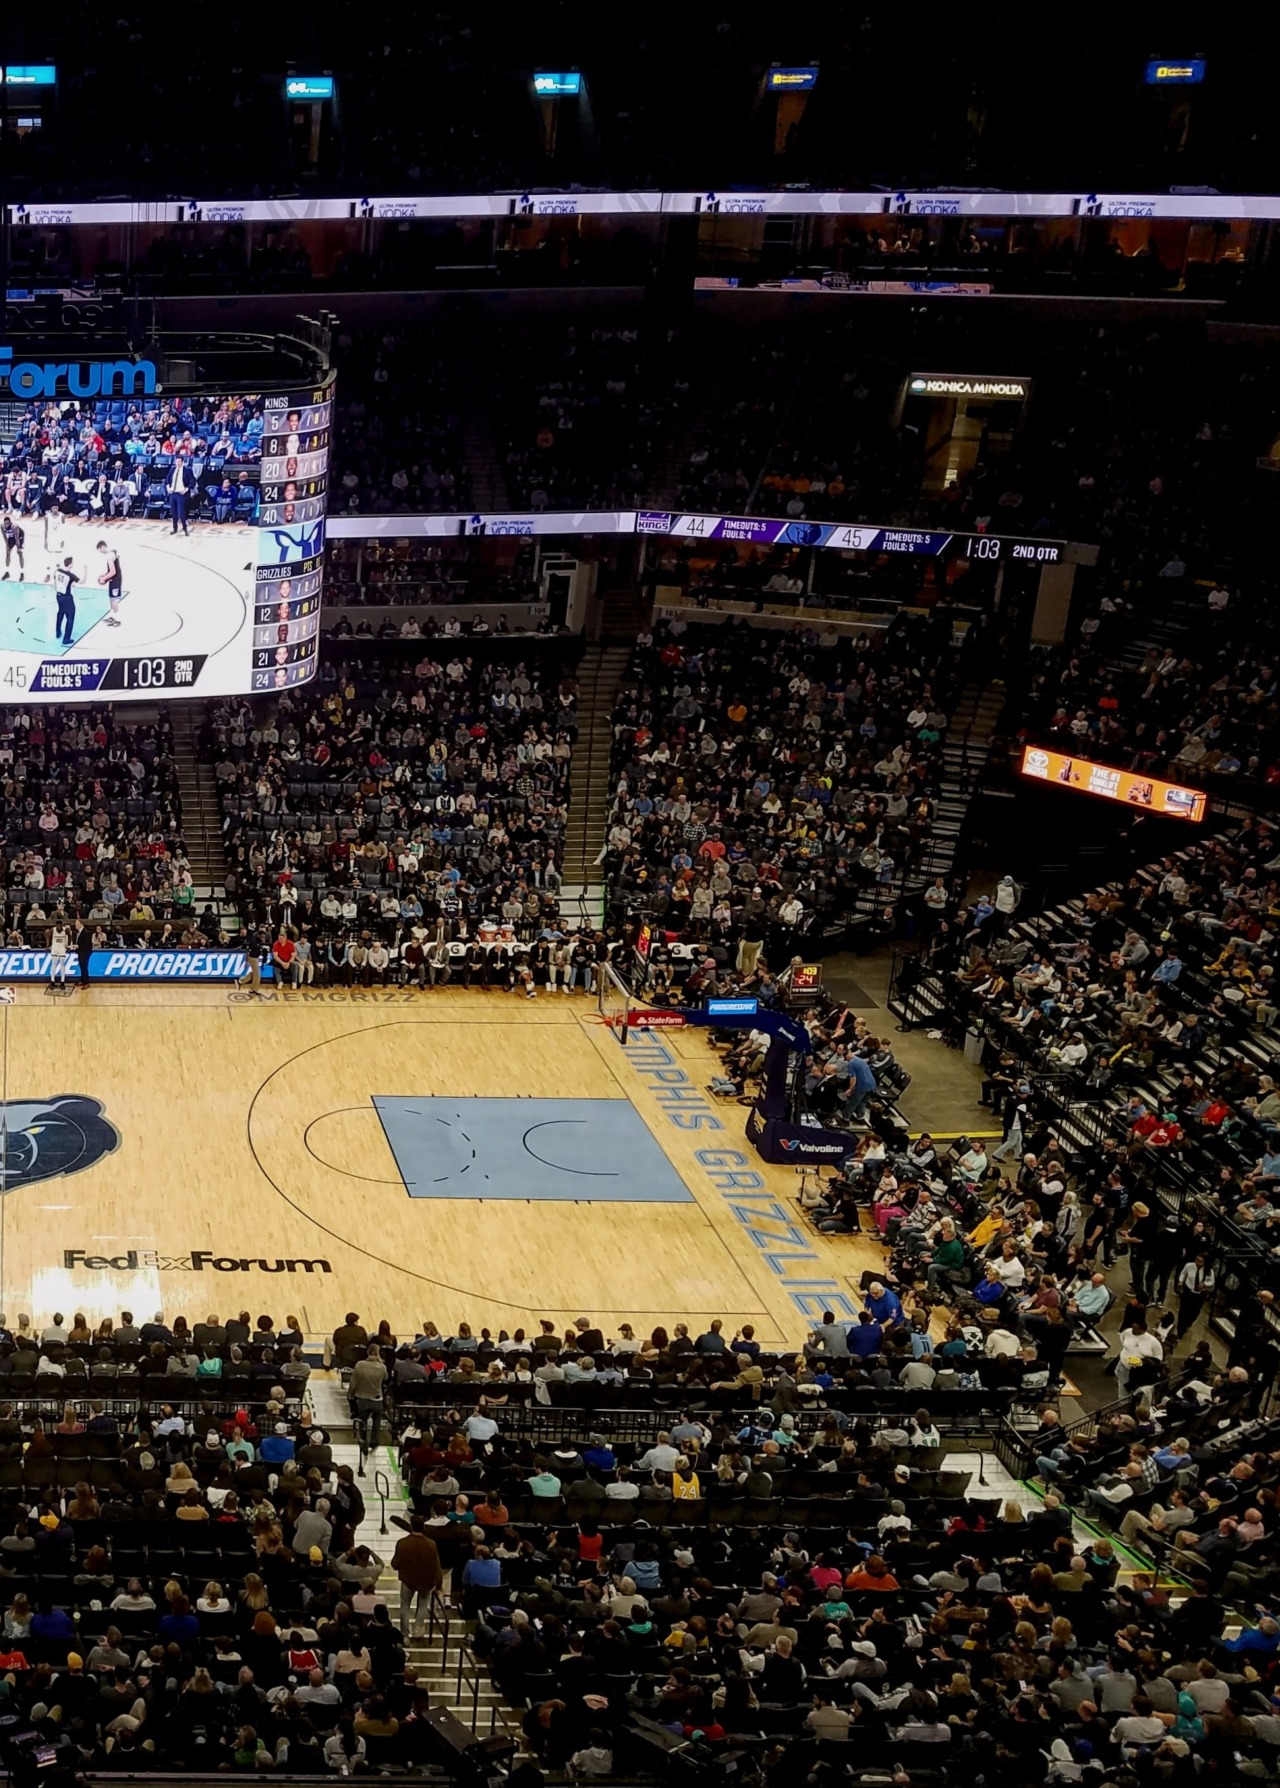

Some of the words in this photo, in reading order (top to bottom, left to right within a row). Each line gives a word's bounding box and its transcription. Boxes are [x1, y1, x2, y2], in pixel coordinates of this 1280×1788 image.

[916, 206, 958, 214] VODKA
[1108, 207, 1153, 216] VODKA
[927, 381, 972, 394] KONICA
[973, 382, 1024, 395] MINOLTA
[265, 397, 288, 409] KINGS
[271, 416, 279, 431] 5
[270, 439, 278, 453] 8
[266, 463, 279, 478] 20
[265, 487, 278, 501] 24
[263, 509, 277, 524] 40
[638, 521, 669, 530] KINGS
[687, 518, 704, 535] 44
[724, 520, 760, 531] TIMEOUTS:
[761, 523, 766, 531] 5
[722, 530, 747, 539] FOULS:
[747, 531, 752, 540] 4
[842, 529, 862, 547] 45
[885, 532, 924, 543] TIMEOUTS:
[925, 535, 931, 543] 5
[883, 541, 908, 551] FOULS:
[967, 538, 1000, 559] 1:03
[1013, 546, 1034, 558] 2ND
[1037, 548, 1058, 560] QTR
[257, 567, 292, 580] GRIZZLIES
[261, 608, 271, 621] 12
[260, 630, 270, 644] 14
[174, 660, 193, 671] 2ND
[258, 652, 269, 666] 21
[4, 666, 27, 687] 45
[41, 664, 91, 676] TIMEOUTS:
[92, 663, 99, 674] 5
[123, 659, 165, 687] 1:03
[41, 676, 74, 688] FOULS:
[74, 676, 81, 687] 5
[175, 671, 192, 683] QTR
[256, 673, 269, 687] 24
[609, 1029, 725, 1130] EMPHIS
[799, 1143, 843, 1152] Valvoline
[63, 1250, 332, 1273] FedExForum
[680, 1486, 696, 1498] 24
